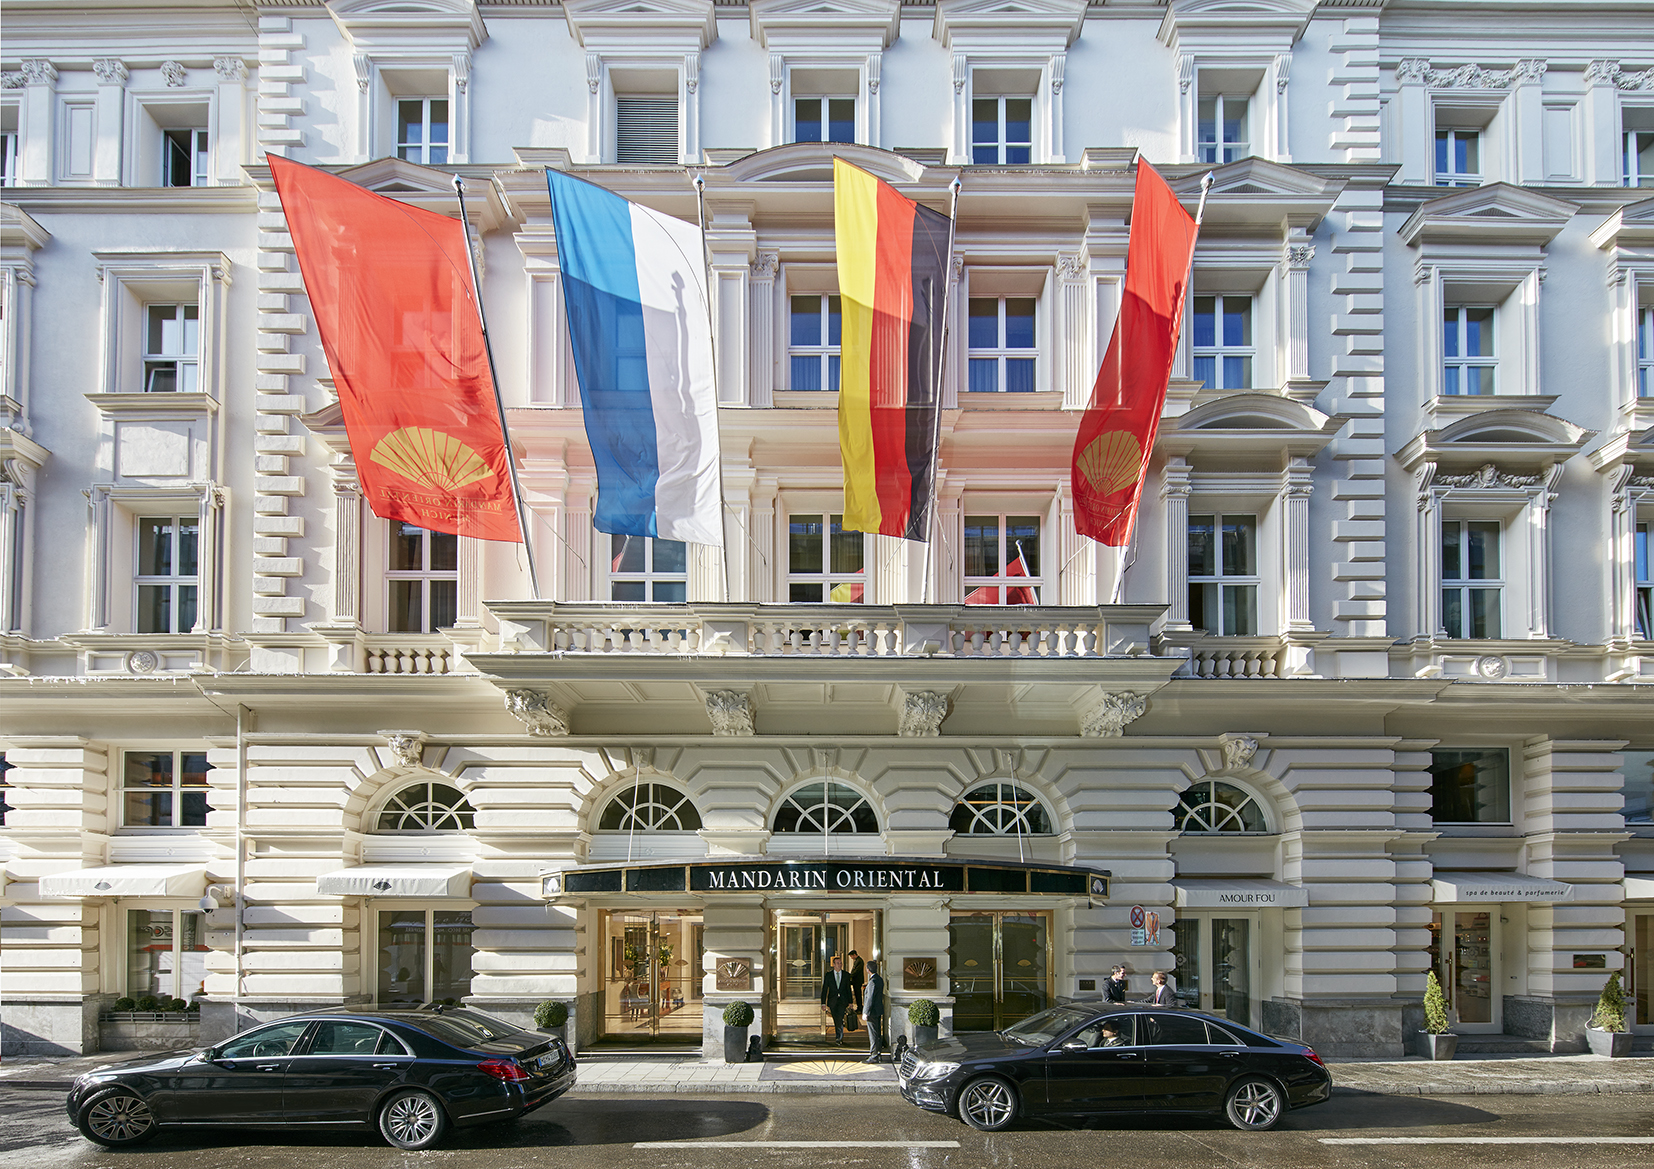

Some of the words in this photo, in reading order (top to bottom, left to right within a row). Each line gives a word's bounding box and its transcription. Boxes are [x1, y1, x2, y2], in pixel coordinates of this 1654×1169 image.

[709, 870, 827, 889] MANDARIN
[836, 869, 944, 888] ORIENTAL
[1525, 889, 1565, 897] parfumerie
[1219, 894, 1254, 903] AMOUR
[1255, 894, 1276, 903] FOU
